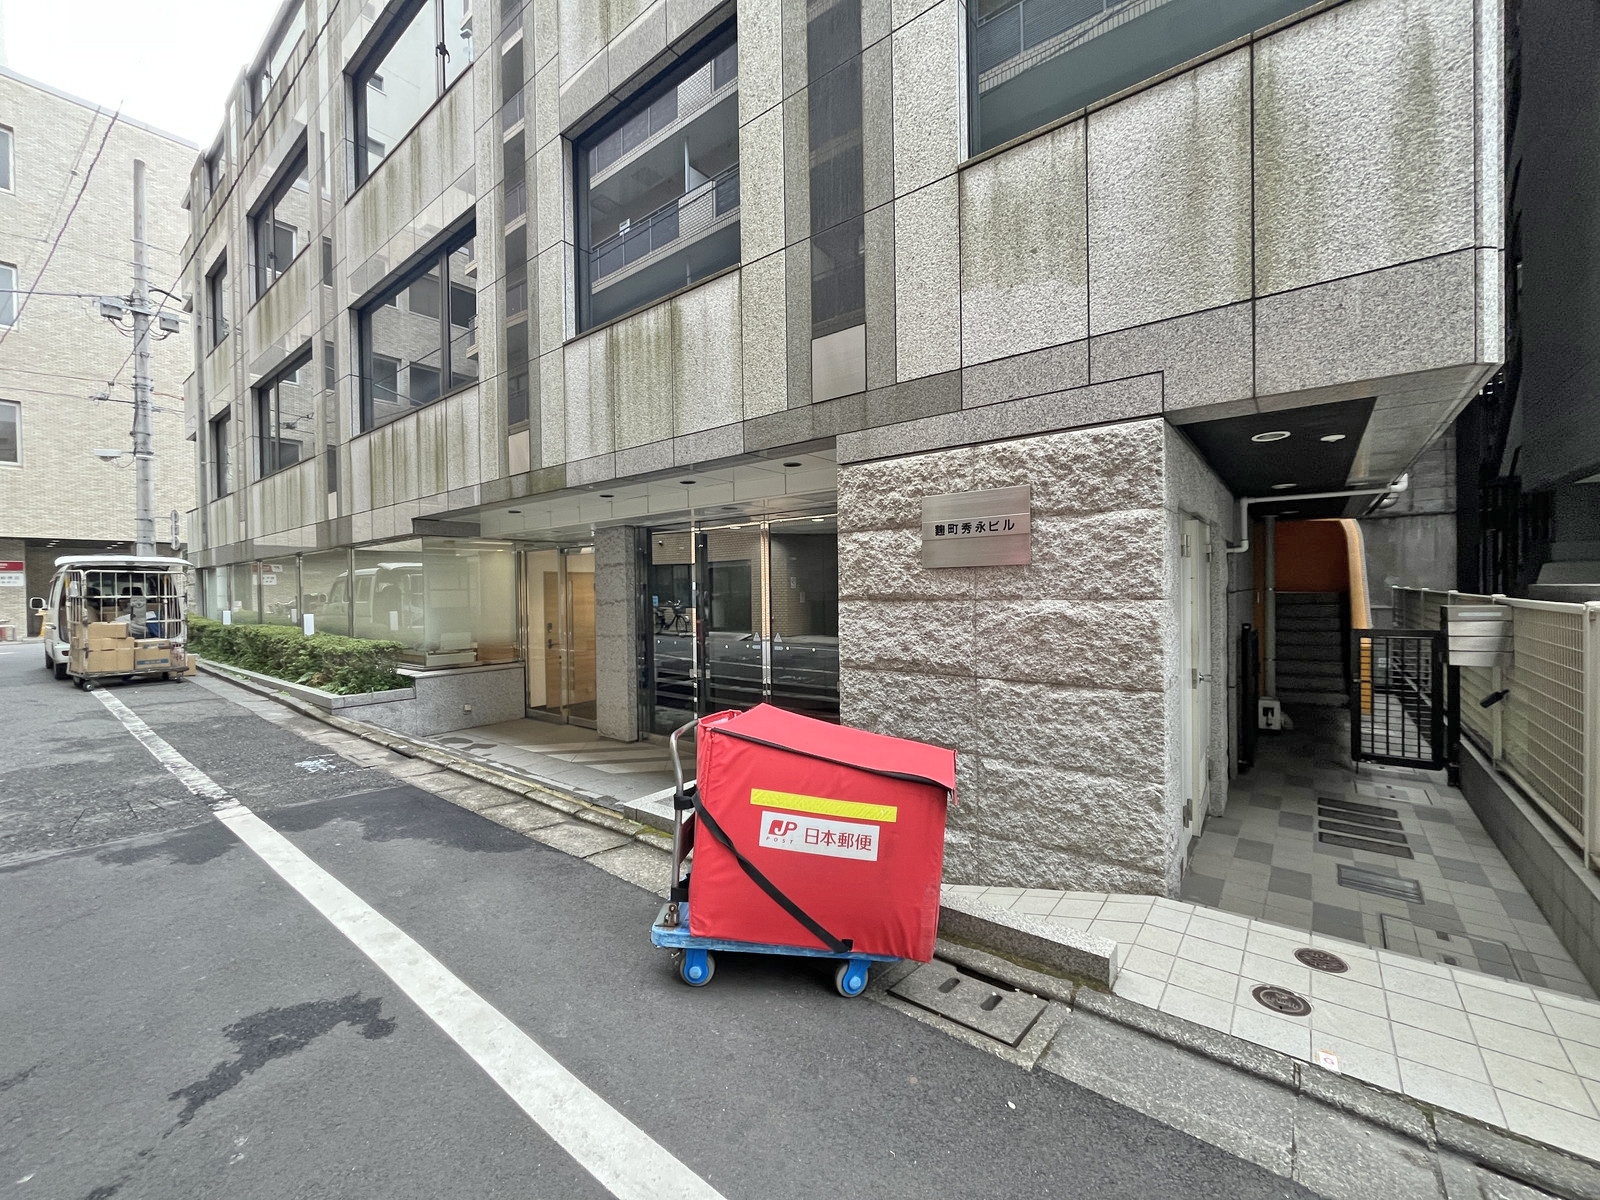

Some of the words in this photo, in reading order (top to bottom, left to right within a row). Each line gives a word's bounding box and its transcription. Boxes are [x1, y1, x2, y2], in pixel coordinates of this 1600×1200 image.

[768, 819, 798, 836] JP
[765, 836, 794, 845] POST
[804, 827, 873, 851] 日本郵便
